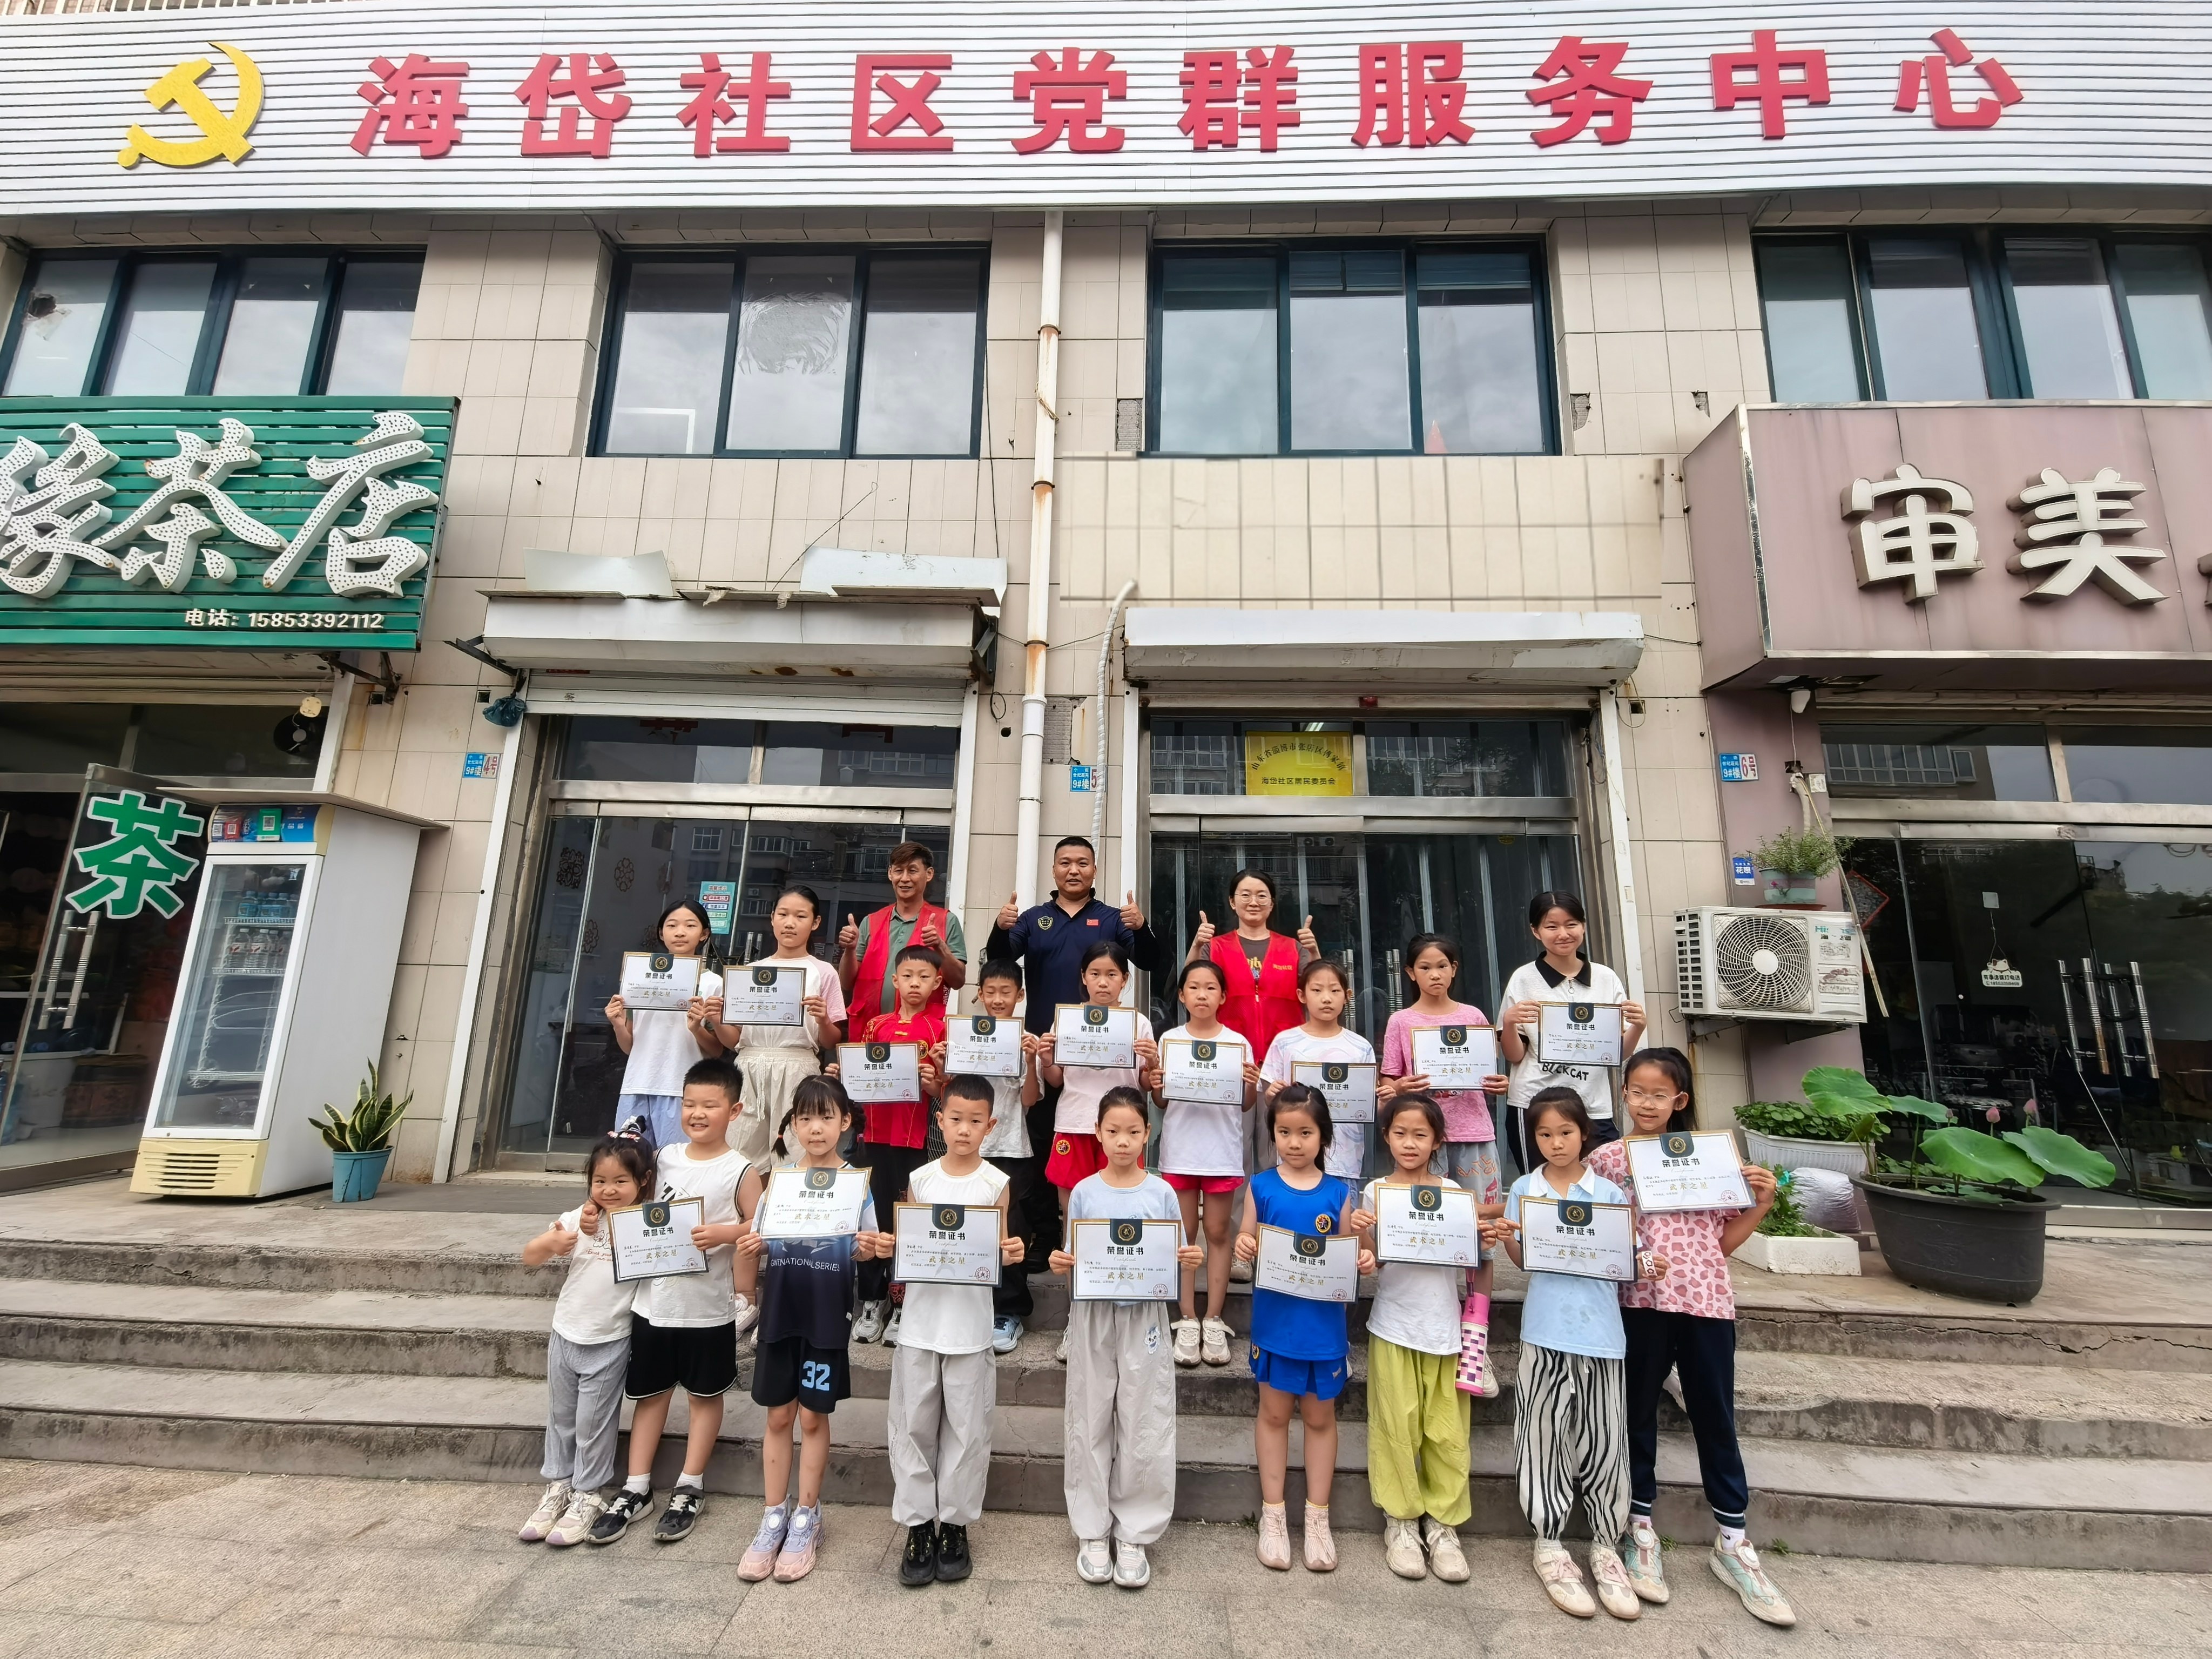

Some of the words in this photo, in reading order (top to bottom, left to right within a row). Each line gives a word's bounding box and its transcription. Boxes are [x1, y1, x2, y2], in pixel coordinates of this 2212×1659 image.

[350, 28, 2023, 159] 海岱社区党群服务中心
[1839, 462, 2212, 606] 审美
[248, 613, 385, 629] 15853392112
[1741, 756, 1756, 778] 6号
[1261, 777, 1337, 785] 海岱社区居民委员会
[65, 790, 206, 919] 茶
[799, 1190, 834, 1199] 荣誉证书
[929, 1230, 966, 1240] 荣誉证书
[1107, 1246, 1144, 1256] 荣誉证书
[928, 1256, 966, 1265] 武术之星
[1107, 1272, 1144, 1280] 武术之星
[801, 1360, 830, 1391] 32
